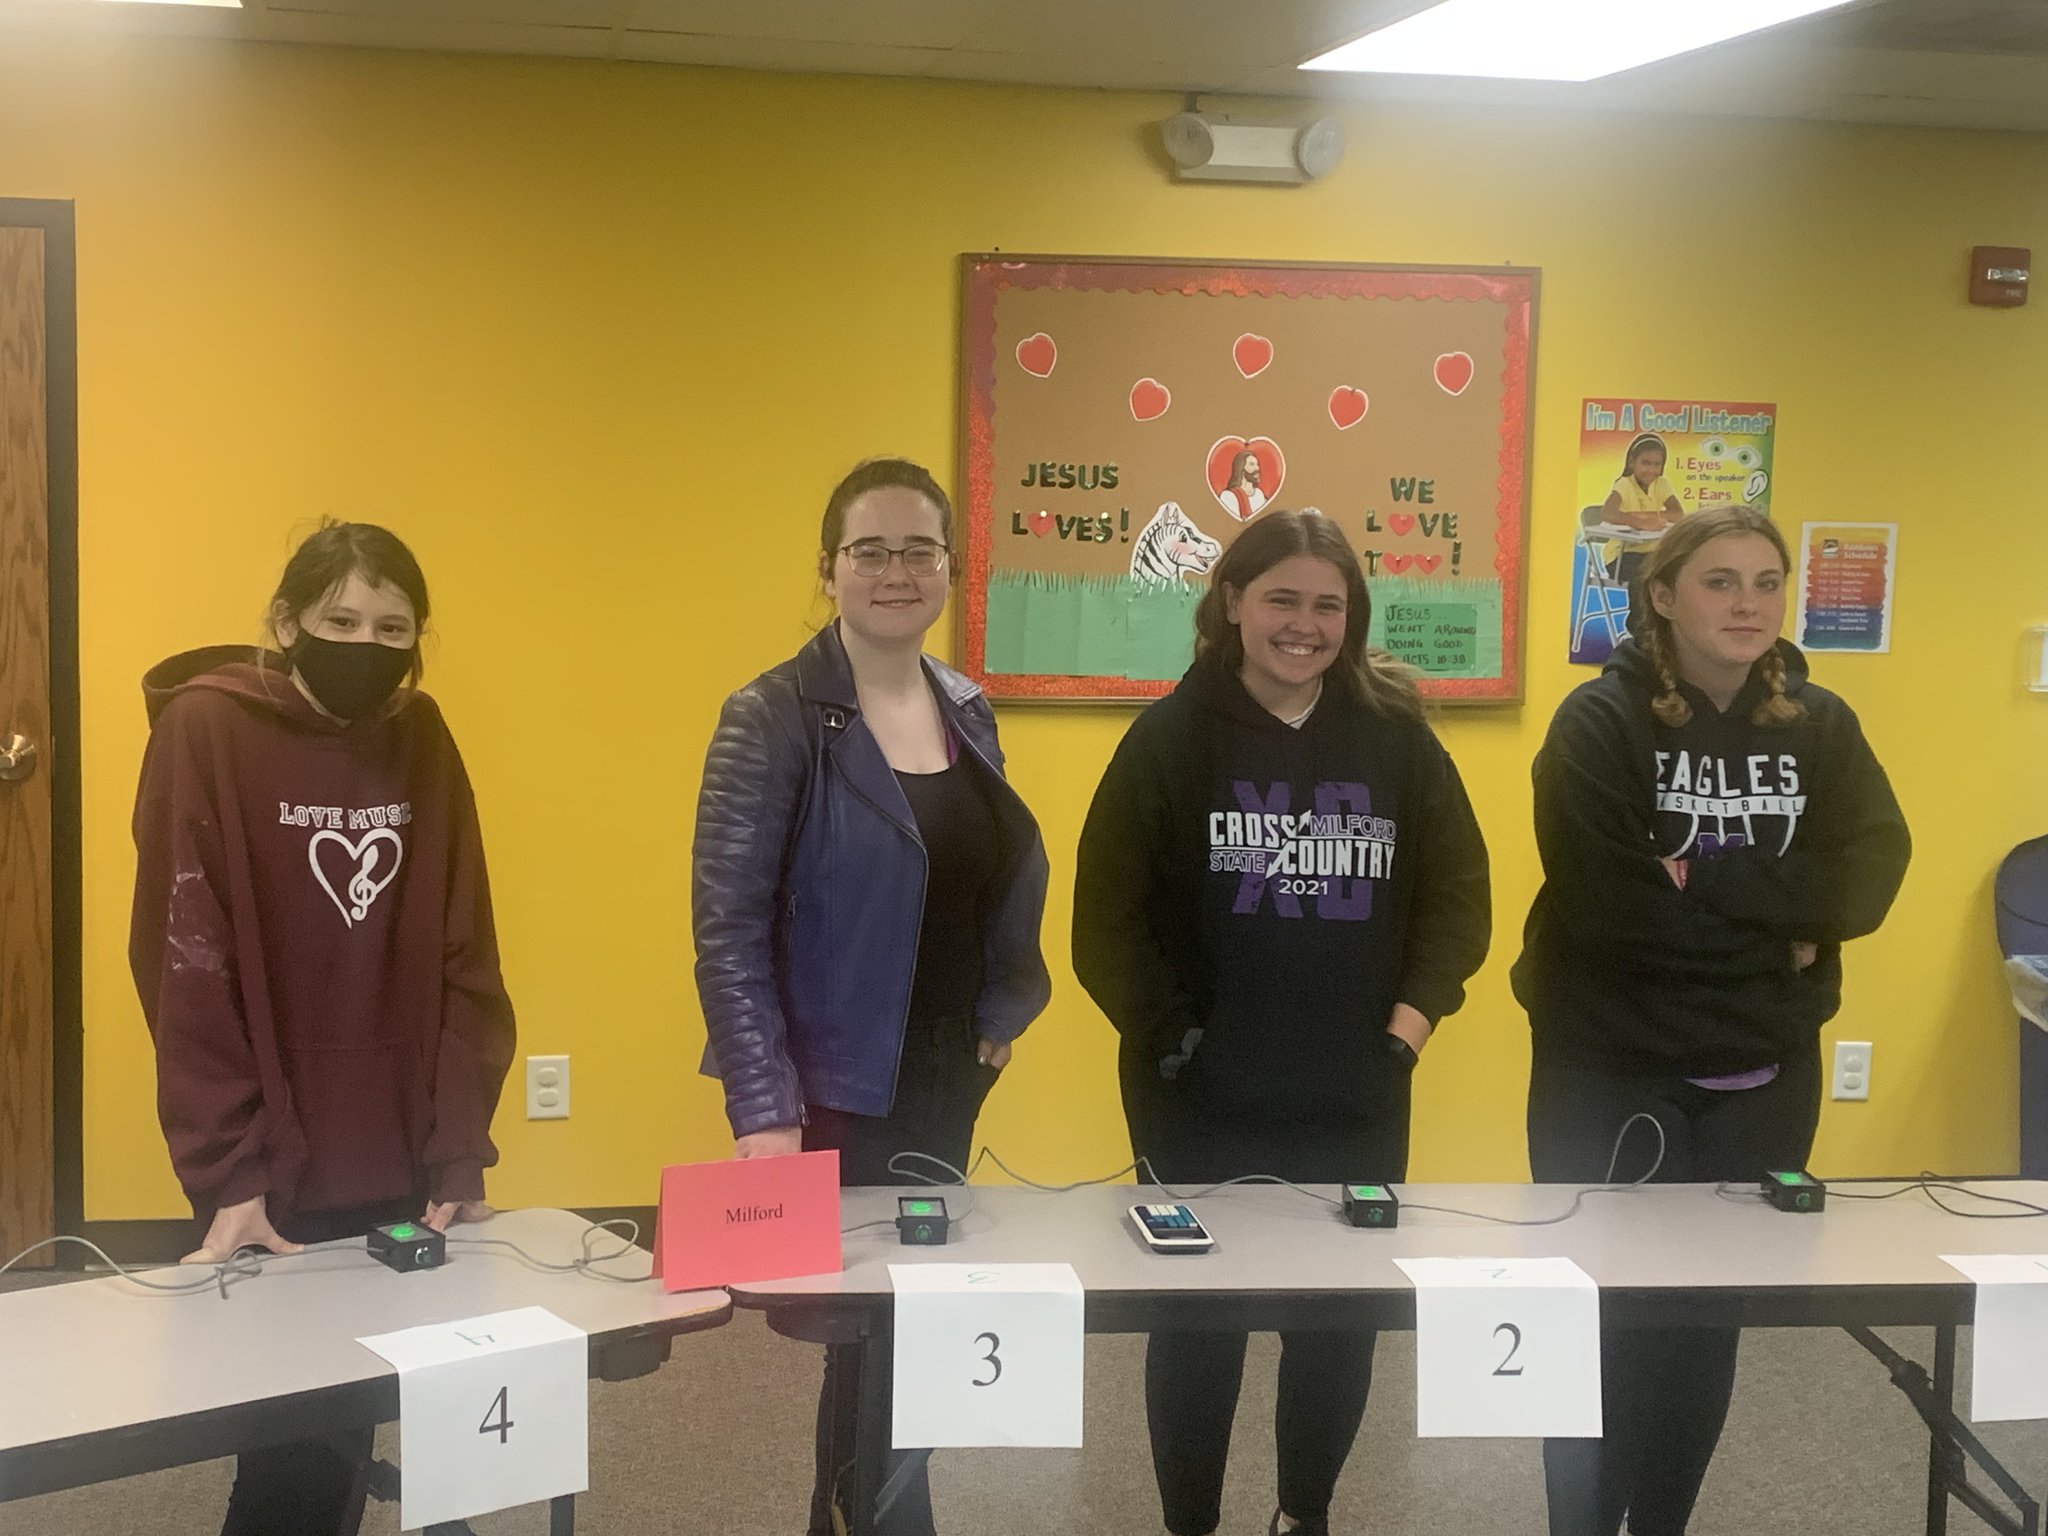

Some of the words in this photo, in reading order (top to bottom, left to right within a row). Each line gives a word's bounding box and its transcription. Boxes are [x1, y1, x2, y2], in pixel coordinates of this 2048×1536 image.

[1586, 402, 1615, 431] I'm
[1619, 403, 1635, 431] A
[1640, 403, 1689, 432] Good
[1692, 405, 1773, 434] Listener
[1021, 461, 1119, 490] JESUS
[1675, 457, 1684, 470] 1.
[1687, 457, 1721, 472] Eyes
[1699, 472, 1712, 481] the
[1714, 473, 1745, 483] speaker
[1390, 477, 1434, 504] WE
[1684, 487, 1696, 500] 2.
[1698, 487, 1732, 500] Ears
[1012, 508, 1129, 544] LVES!
[1366, 508, 1457, 539] LVE
[1387, 624, 1425, 634] WENT
[1434, 623, 1476, 636] AROUND
[1386, 639, 1423, 649] DOING
[1434, 640, 1463, 648] GOOD
[1403, 654, 1429, 664] ACTS
[1655, 750, 1800, 797] EAGLES
[279, 802, 343, 828] LOVE
[1209, 811, 1297, 849] CROSS
[1309, 814, 1397, 847] MILFORD
[1209, 850, 1266, 874] STATE
[1281, 839, 1396, 880] COUNTRY
[1278, 879, 1329, 895] 2021
[725, 1203, 783, 1224] Milford
[972, 1331, 1002, 1387] 3
[1491, 1322, 1524, 1376] 2
[479, 1386, 514, 1444] 4
